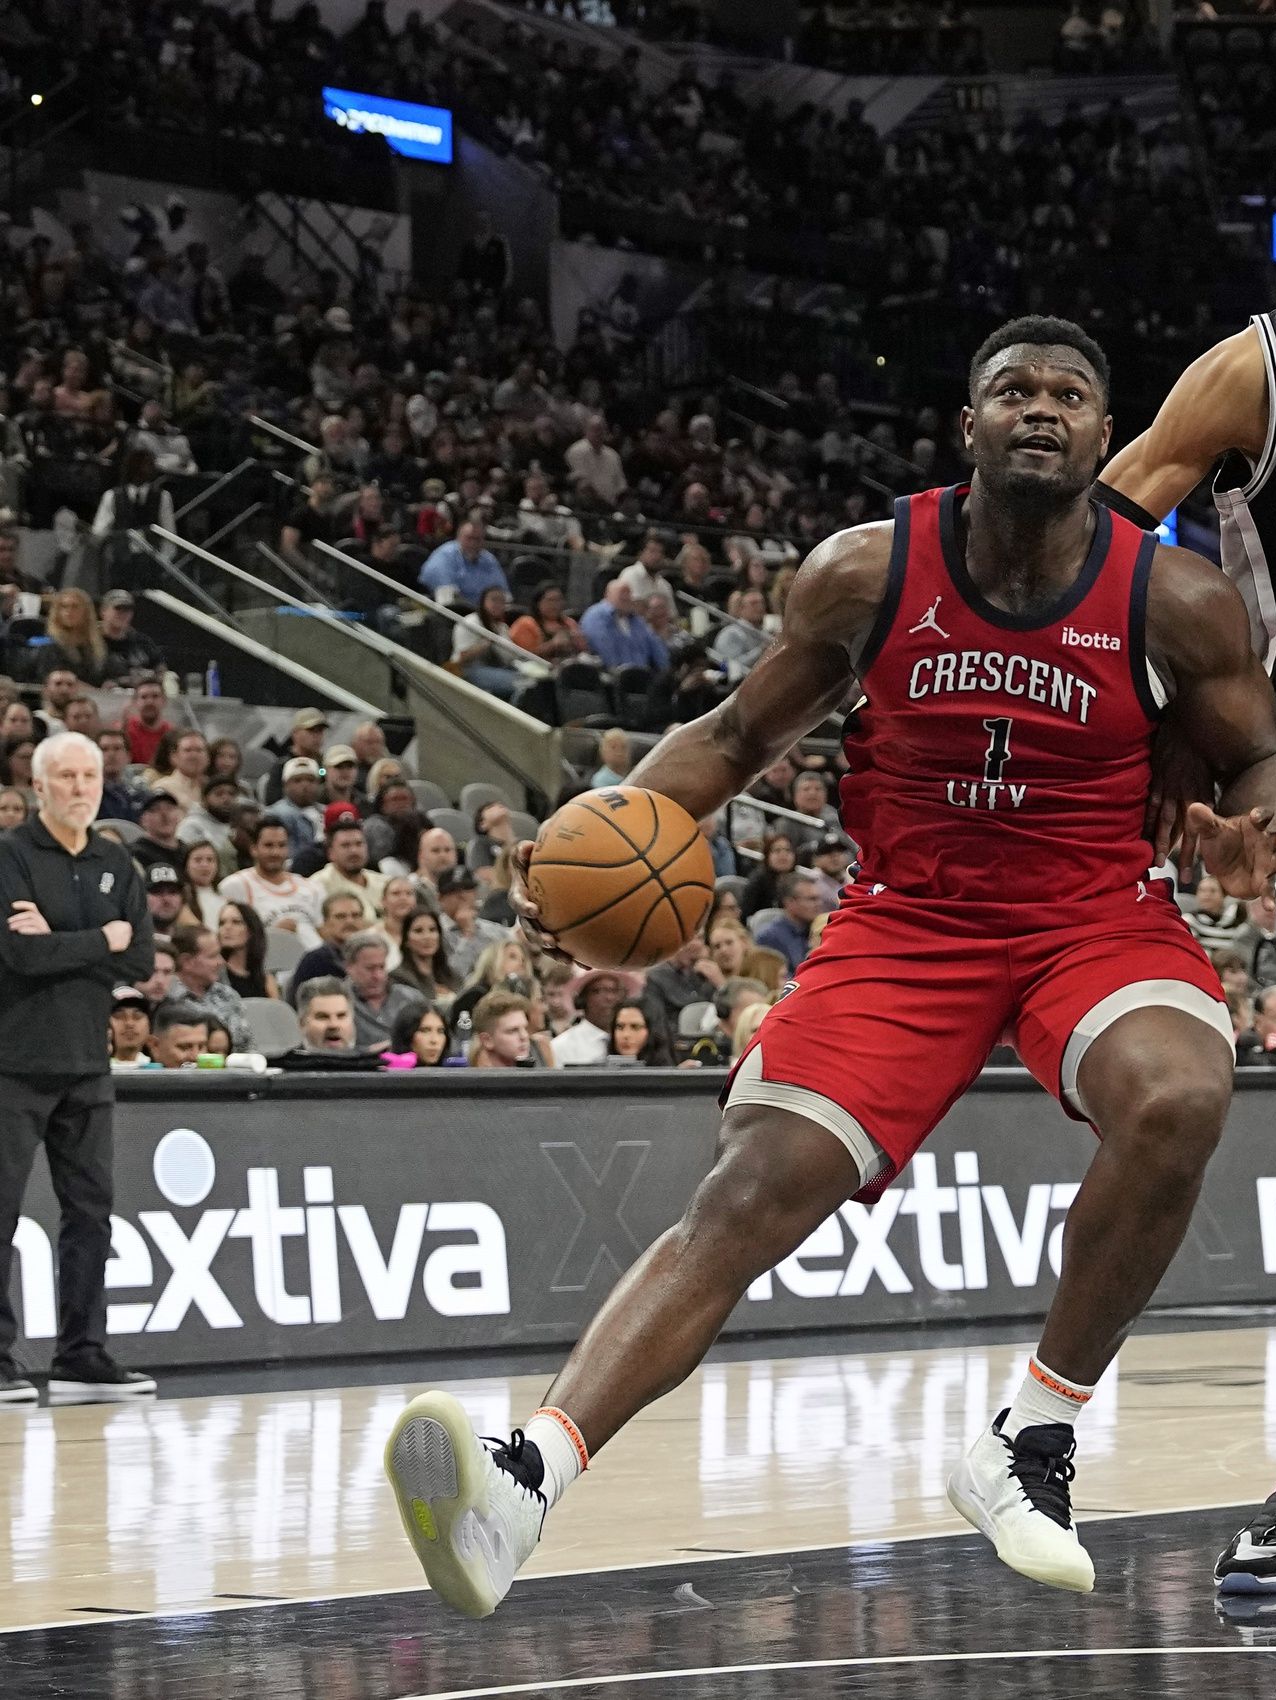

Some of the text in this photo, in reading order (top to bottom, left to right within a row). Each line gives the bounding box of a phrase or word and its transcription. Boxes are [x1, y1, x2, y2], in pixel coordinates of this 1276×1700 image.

[1062, 627, 1121, 651] ibotta
[908, 651, 1097, 724] CRESCENT
[982, 717, 1014, 783] 1
[946, 780, 1027, 810] CITY
